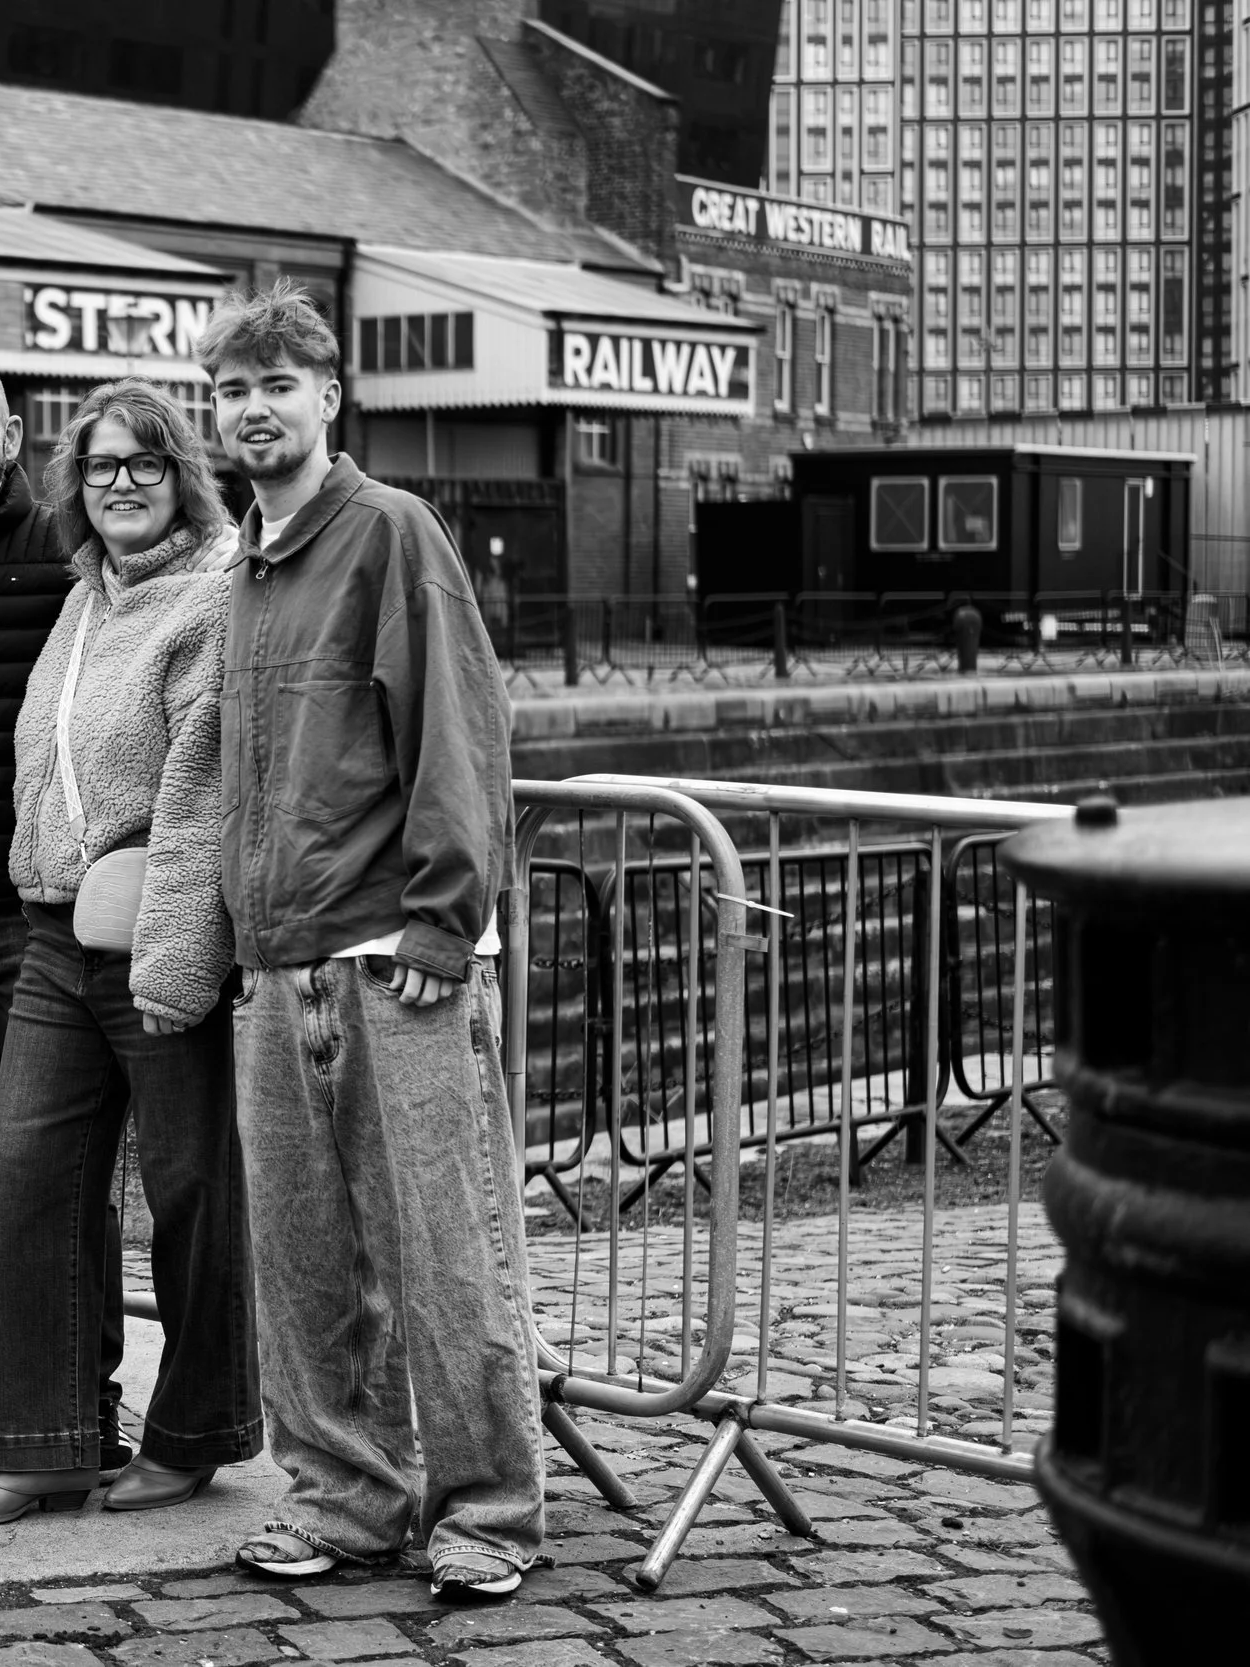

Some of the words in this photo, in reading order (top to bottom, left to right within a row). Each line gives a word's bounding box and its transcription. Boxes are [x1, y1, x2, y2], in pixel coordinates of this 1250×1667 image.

[692, 187, 760, 236] GREAT
[765, 201, 862, 253] WESTERN
[563, 333, 737, 397] RAILWAY
